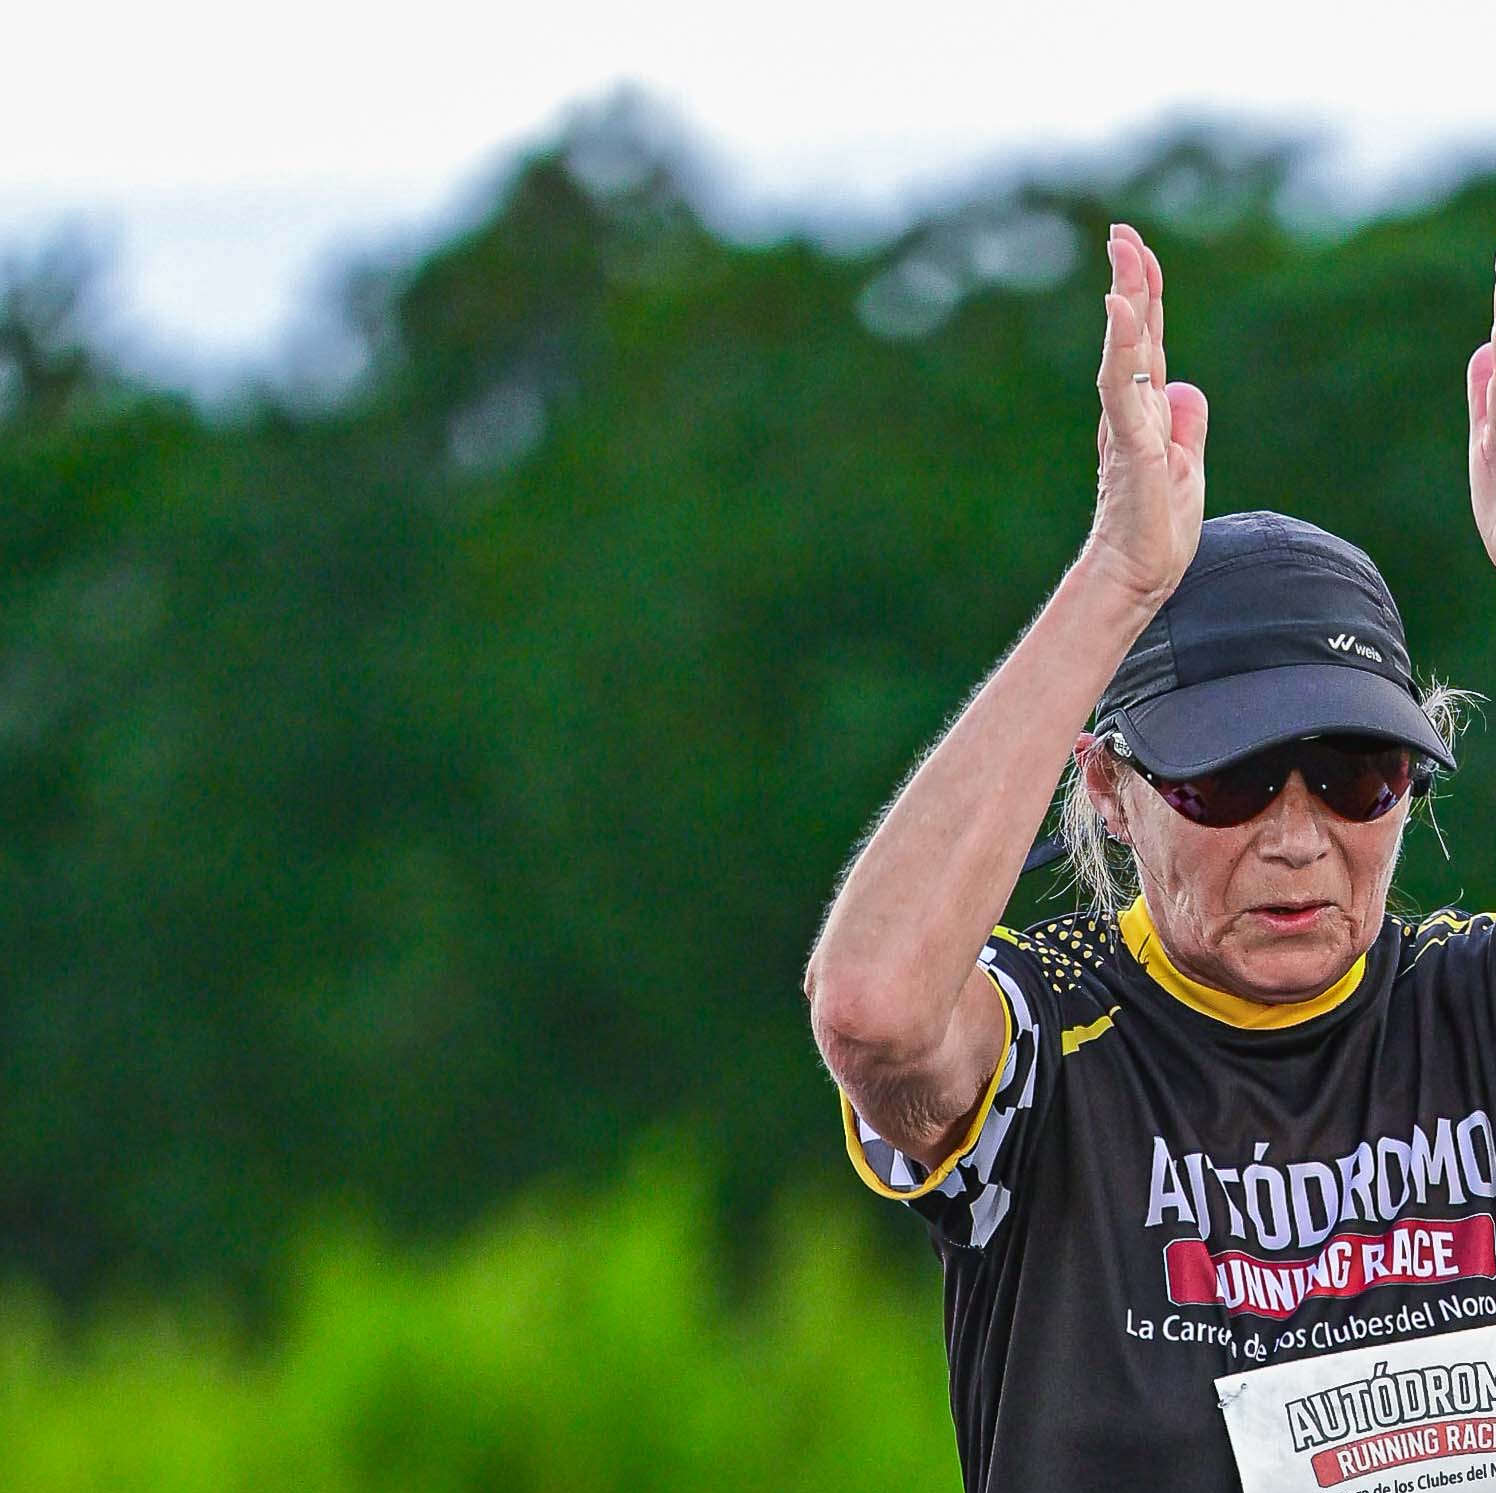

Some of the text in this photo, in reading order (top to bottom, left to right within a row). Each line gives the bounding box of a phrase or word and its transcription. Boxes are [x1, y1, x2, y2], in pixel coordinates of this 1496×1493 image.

[1355, 642, 1382, 663] weis
[1215, 1229, 1459, 1311] UNNING RACE
[1126, 1308, 1154, 1341] La
[1244, 1332, 1267, 1362] de
[1336, 1428, 1440, 1478] RUNNING
[1417, 1471, 1463, 1490] Clubes
[1466, 1463, 1487, 1481] del
